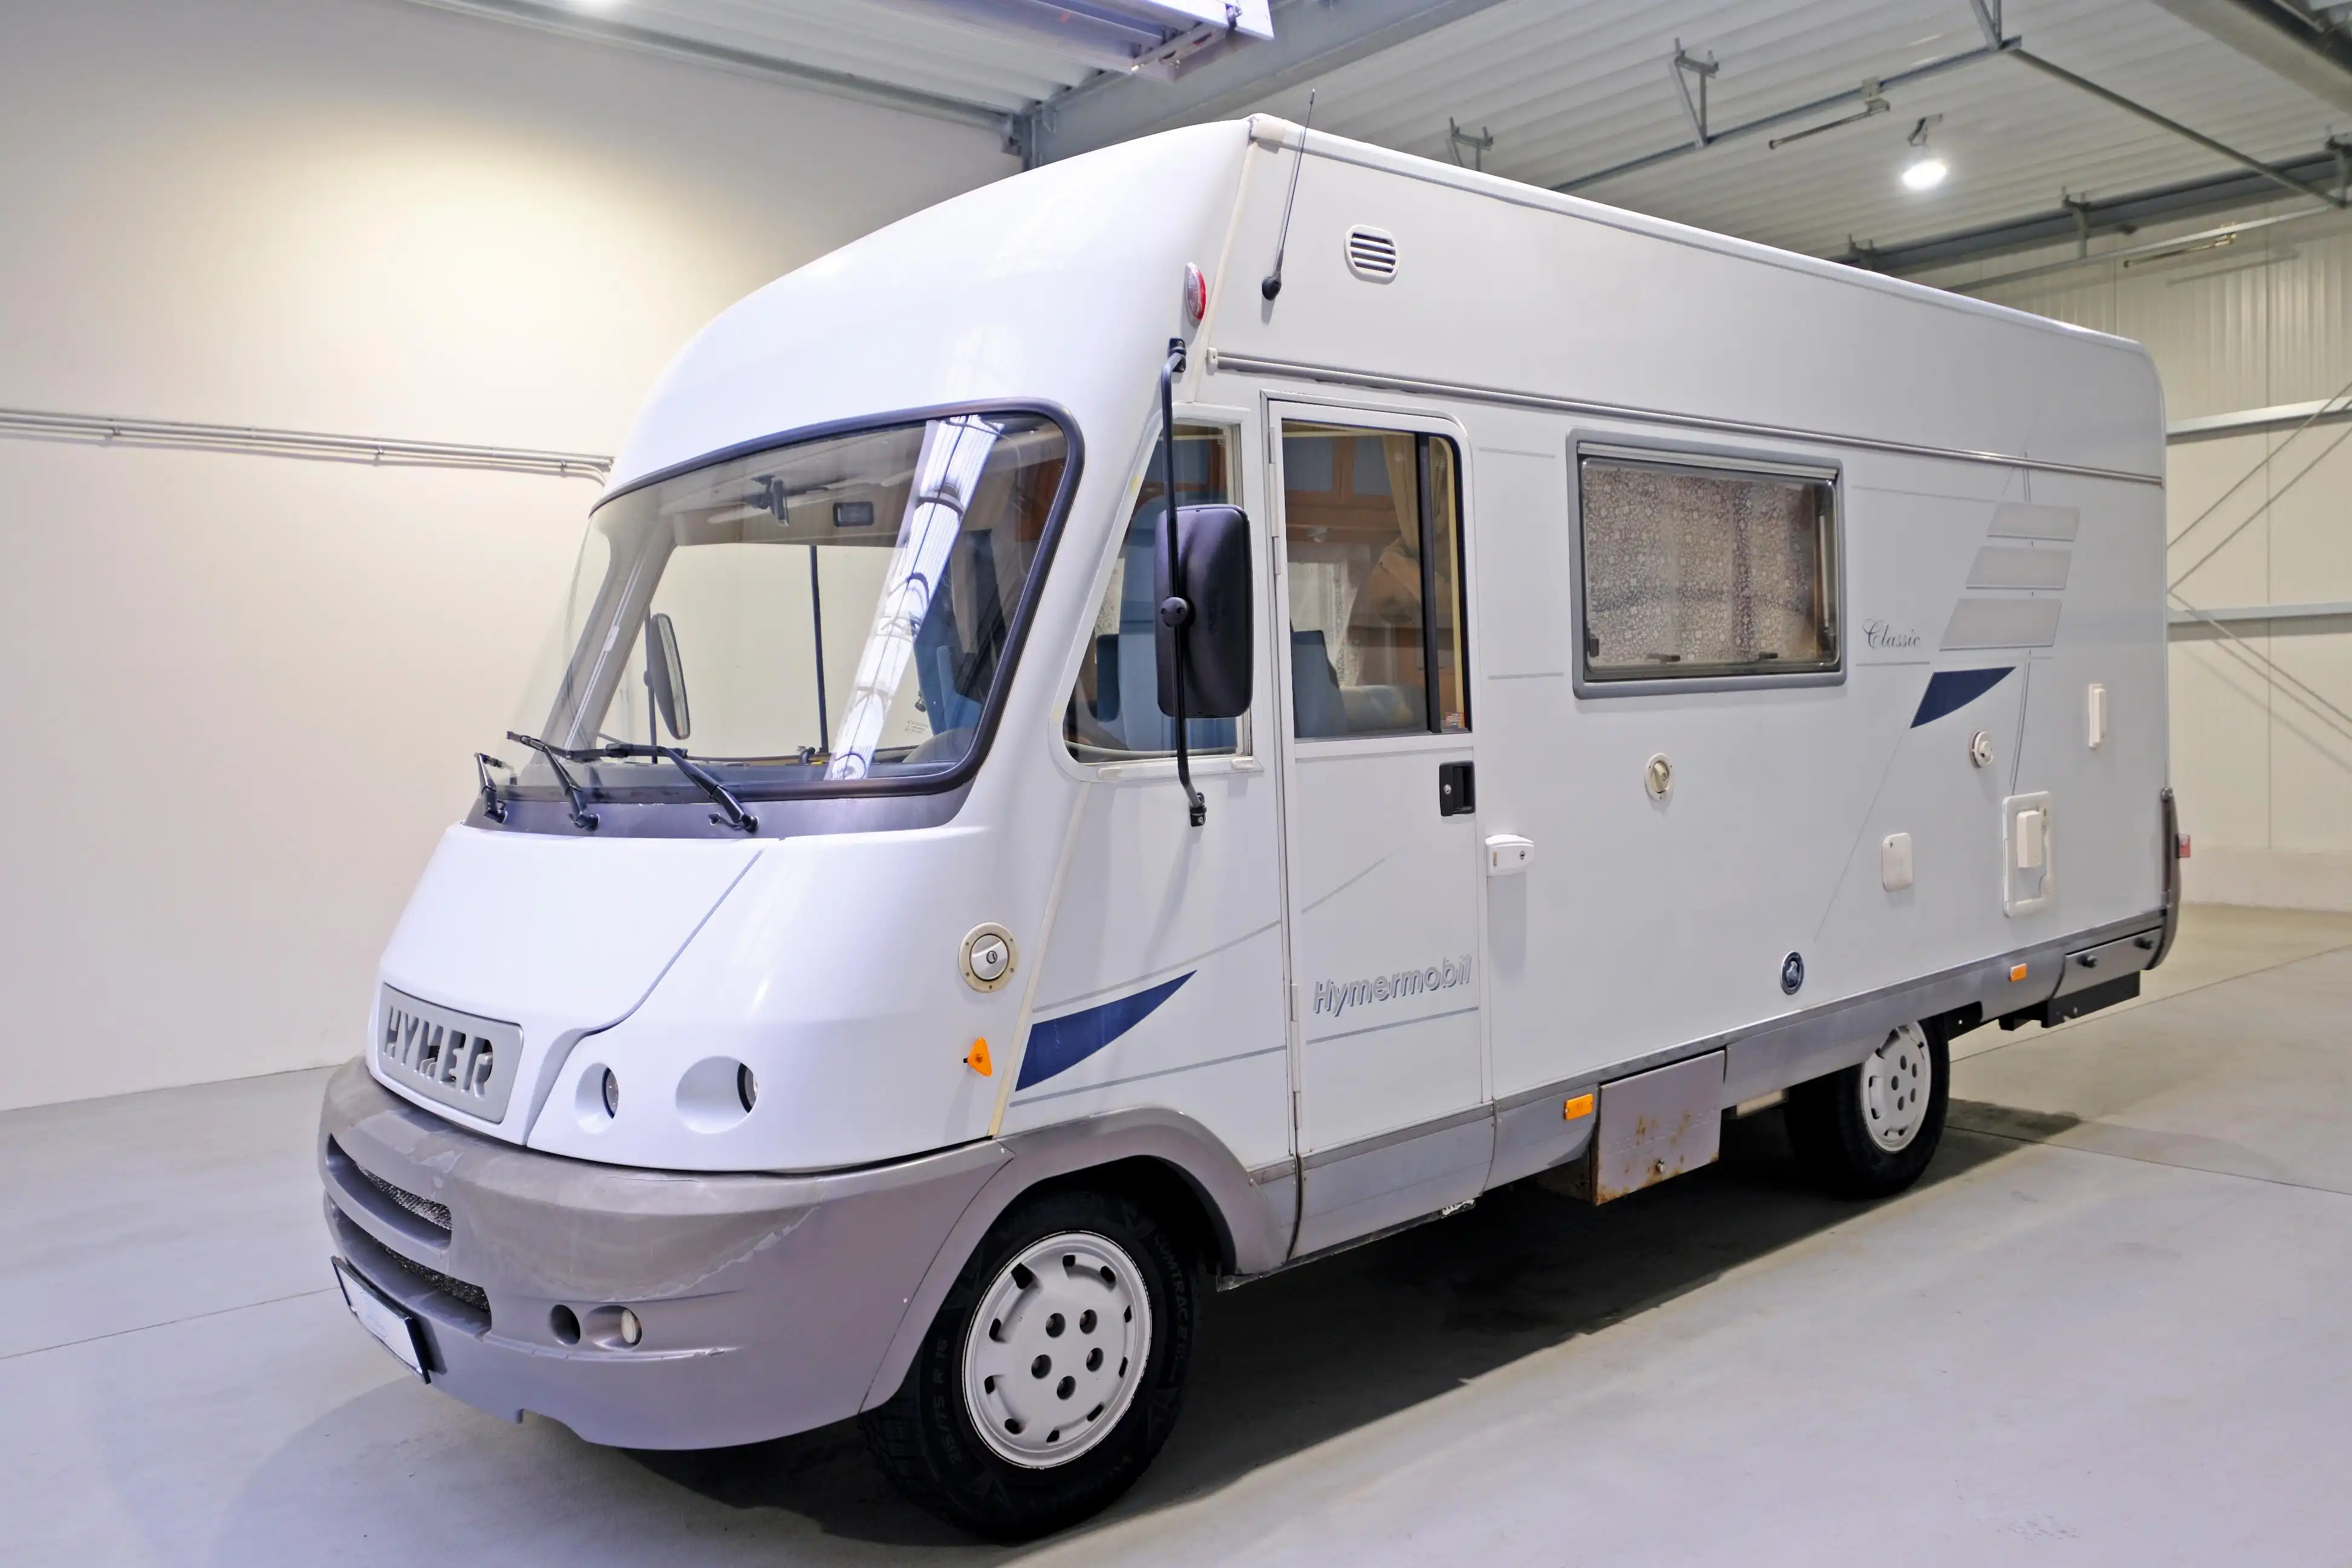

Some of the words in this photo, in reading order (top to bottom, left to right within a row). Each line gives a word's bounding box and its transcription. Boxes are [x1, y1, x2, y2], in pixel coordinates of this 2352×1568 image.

[1863, 618, 1921, 648] Classic
[1312, 953, 1472, 1018] Hymermobil
[383, 1005, 494, 1099] HYMER
